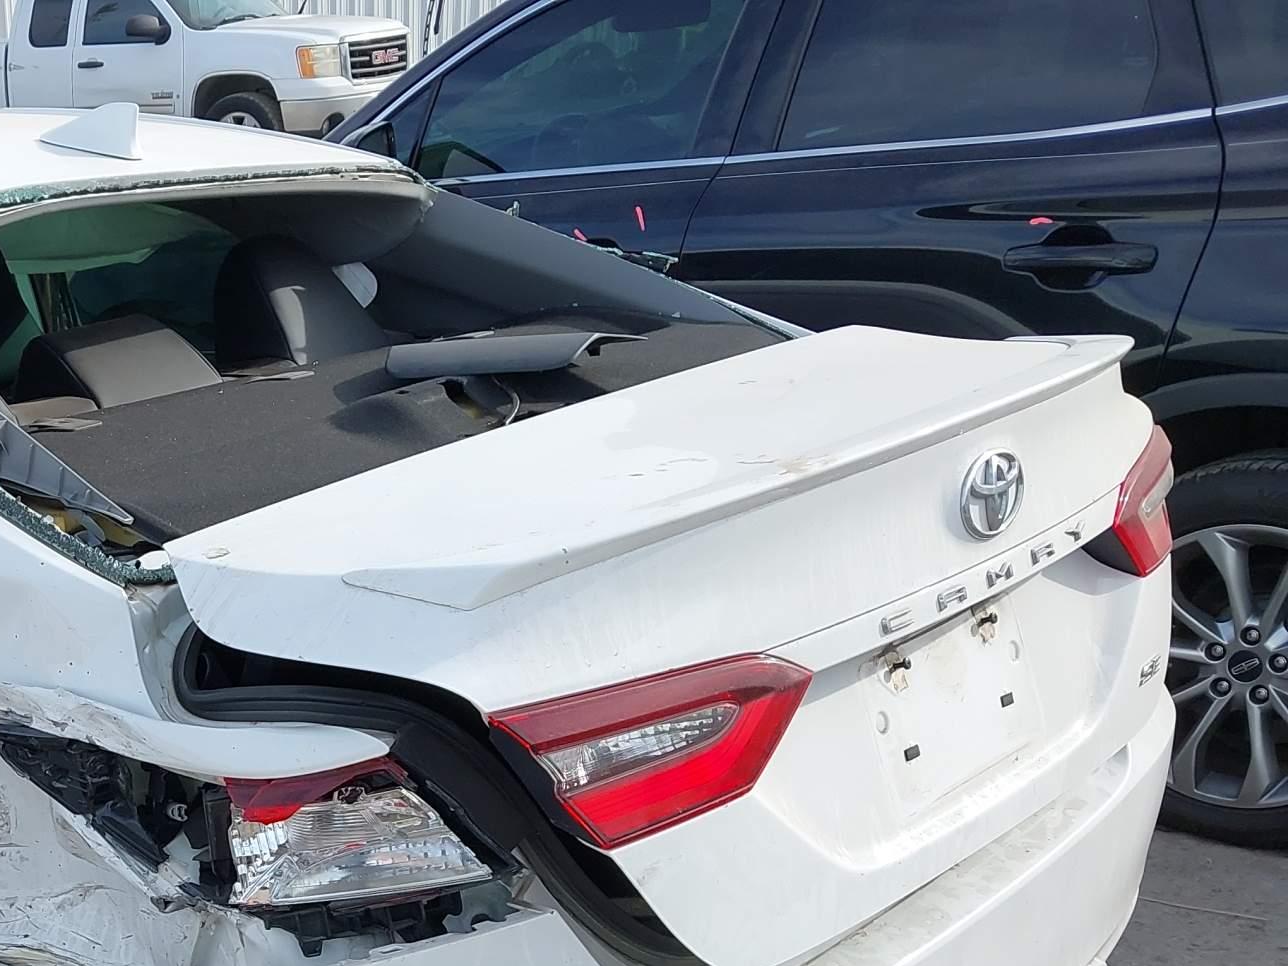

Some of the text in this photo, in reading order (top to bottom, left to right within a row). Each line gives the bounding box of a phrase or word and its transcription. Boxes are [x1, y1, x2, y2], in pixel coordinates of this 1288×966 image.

[372, 48, 399, 65] GMC
[879, 519, 1086, 637] CAMRY
[1139, 655, 1161, 688] SE
